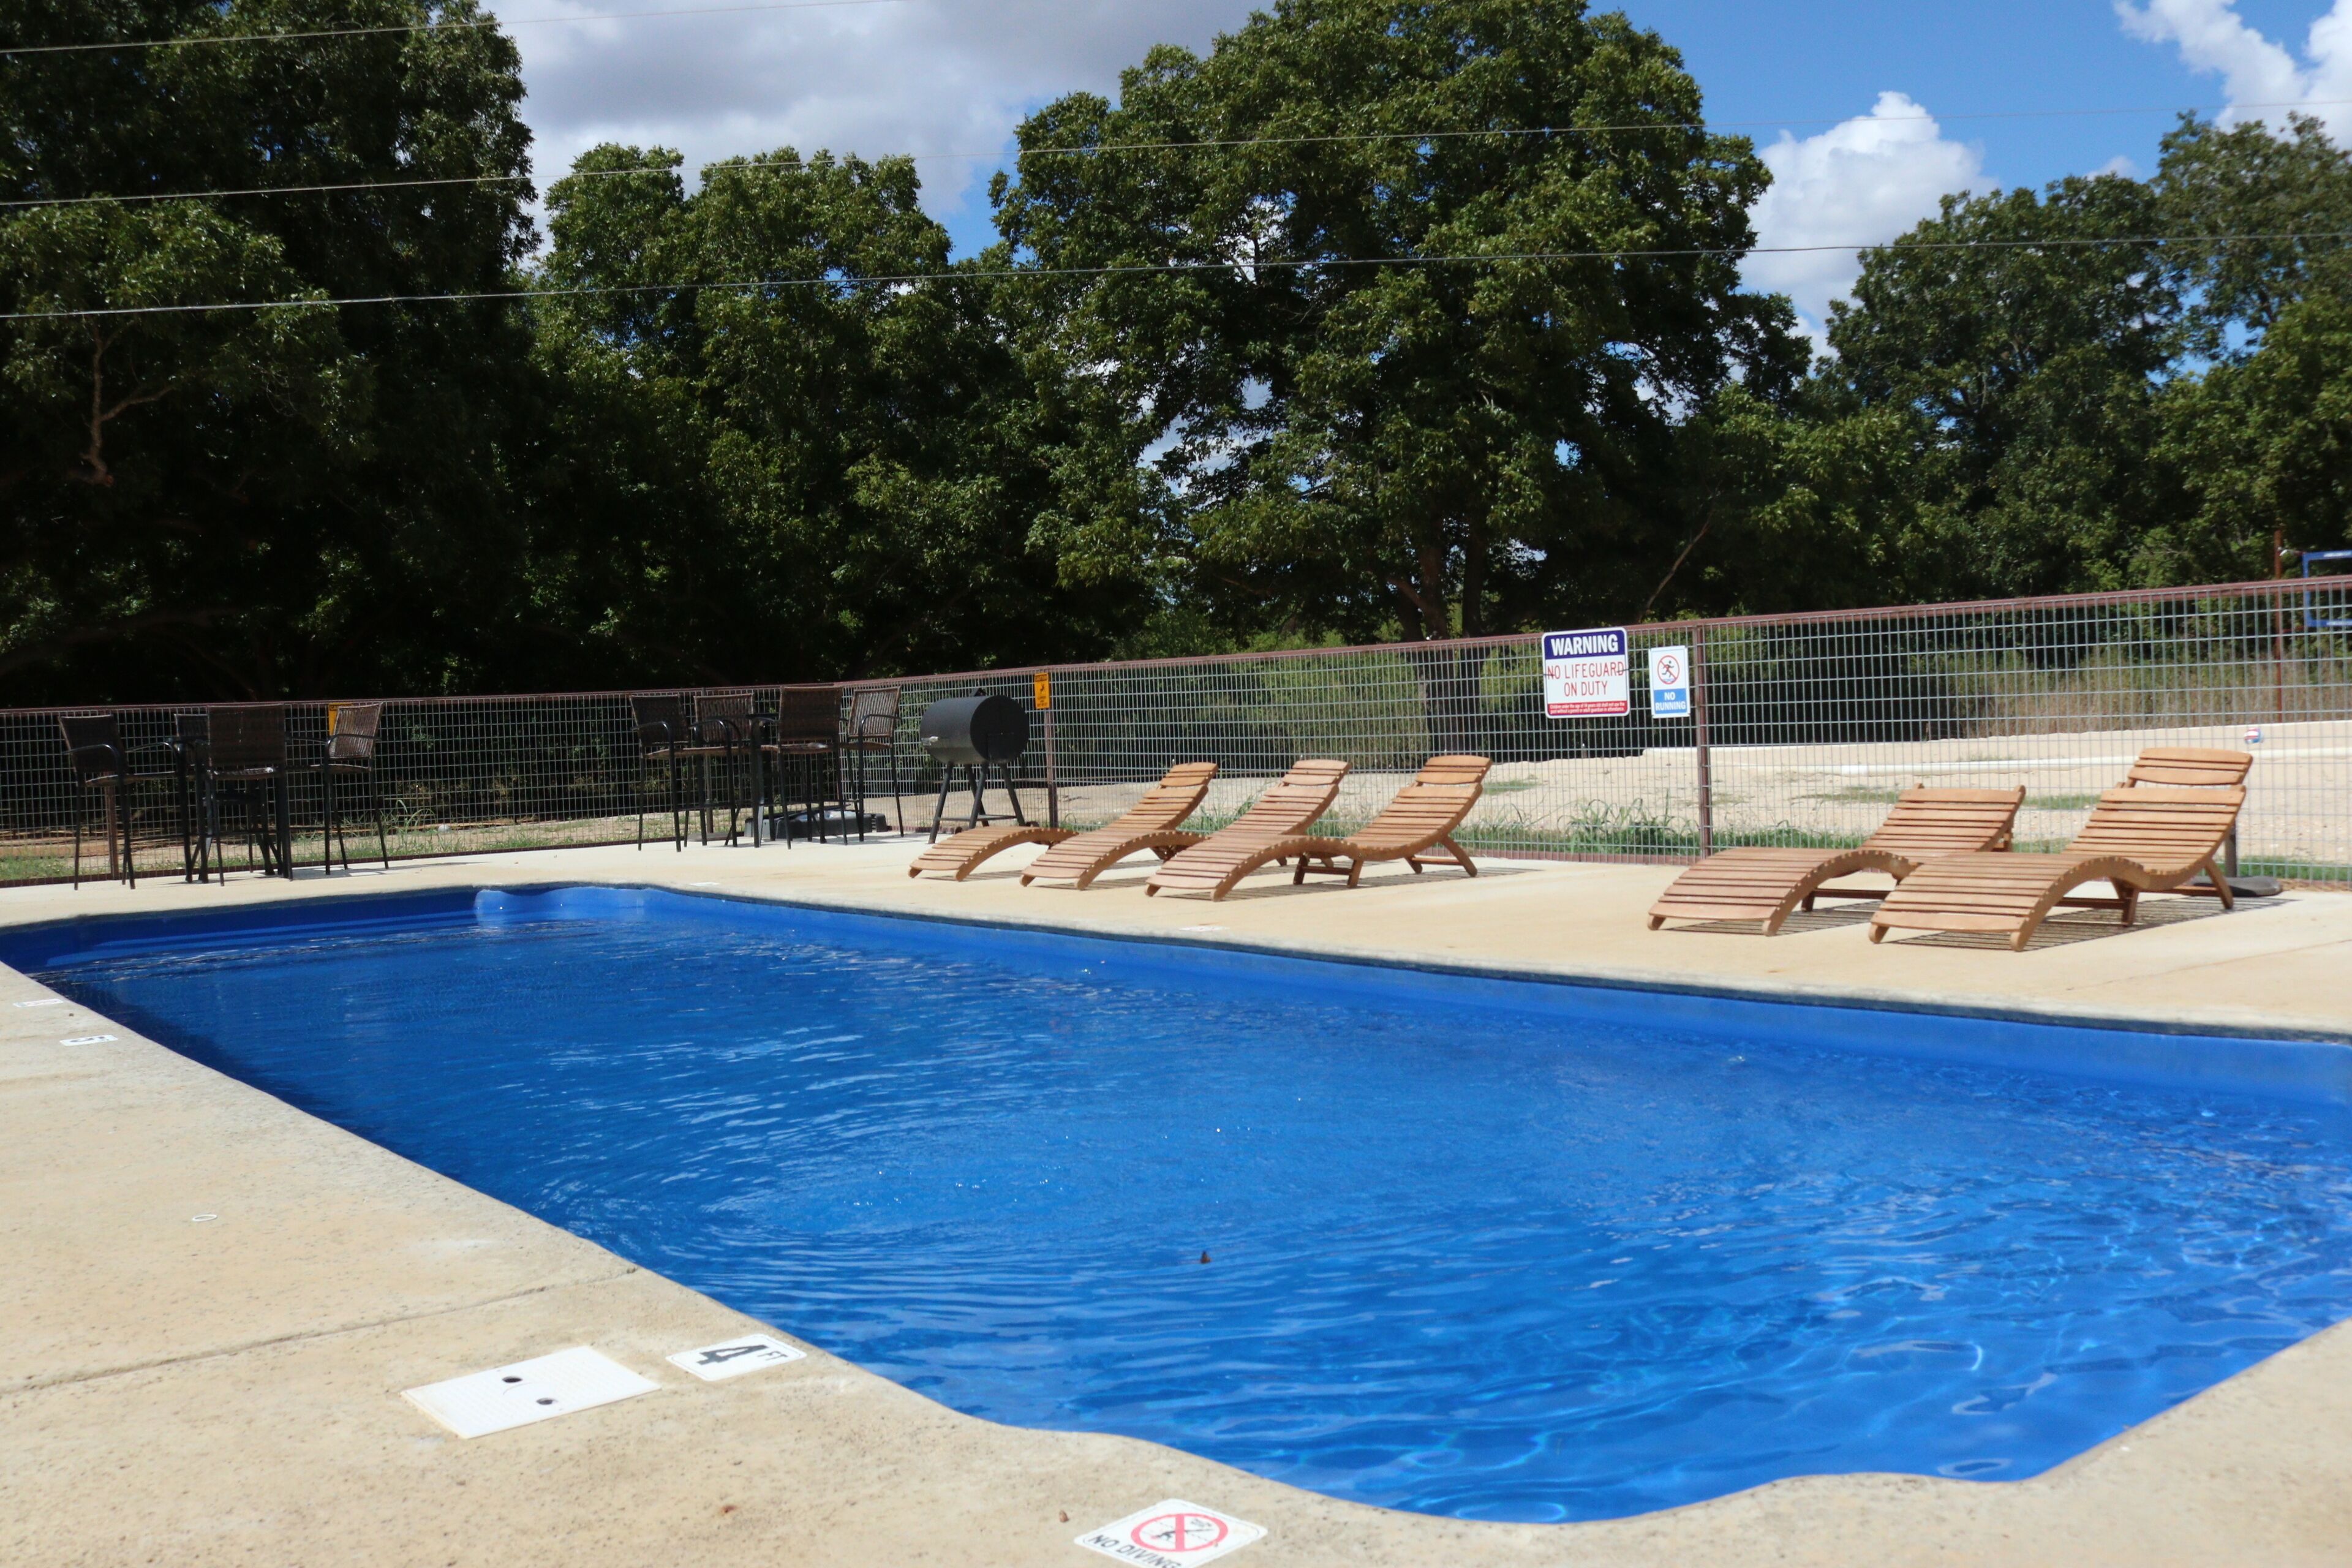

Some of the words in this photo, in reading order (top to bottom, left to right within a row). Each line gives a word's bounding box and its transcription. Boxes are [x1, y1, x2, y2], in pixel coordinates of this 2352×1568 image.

[1551, 634, 1618, 656] WARNING
[1547, 665, 1561, 679] NO
[1565, 662, 1624, 679] LIFEGUARD
[1564, 682, 1577, 696] ON
[1581, 681, 1607, 696] DUTY
[1664, 692, 1676, 701] NO
[1656, 701, 1686, 710] RUNNING
[697, 1344, 769, 1365] 4
[757, 1351, 788, 1361] FT
[1088, 1535, 1120, 1548] NO
[1116, 1545, 1182, 1568] DIVING
